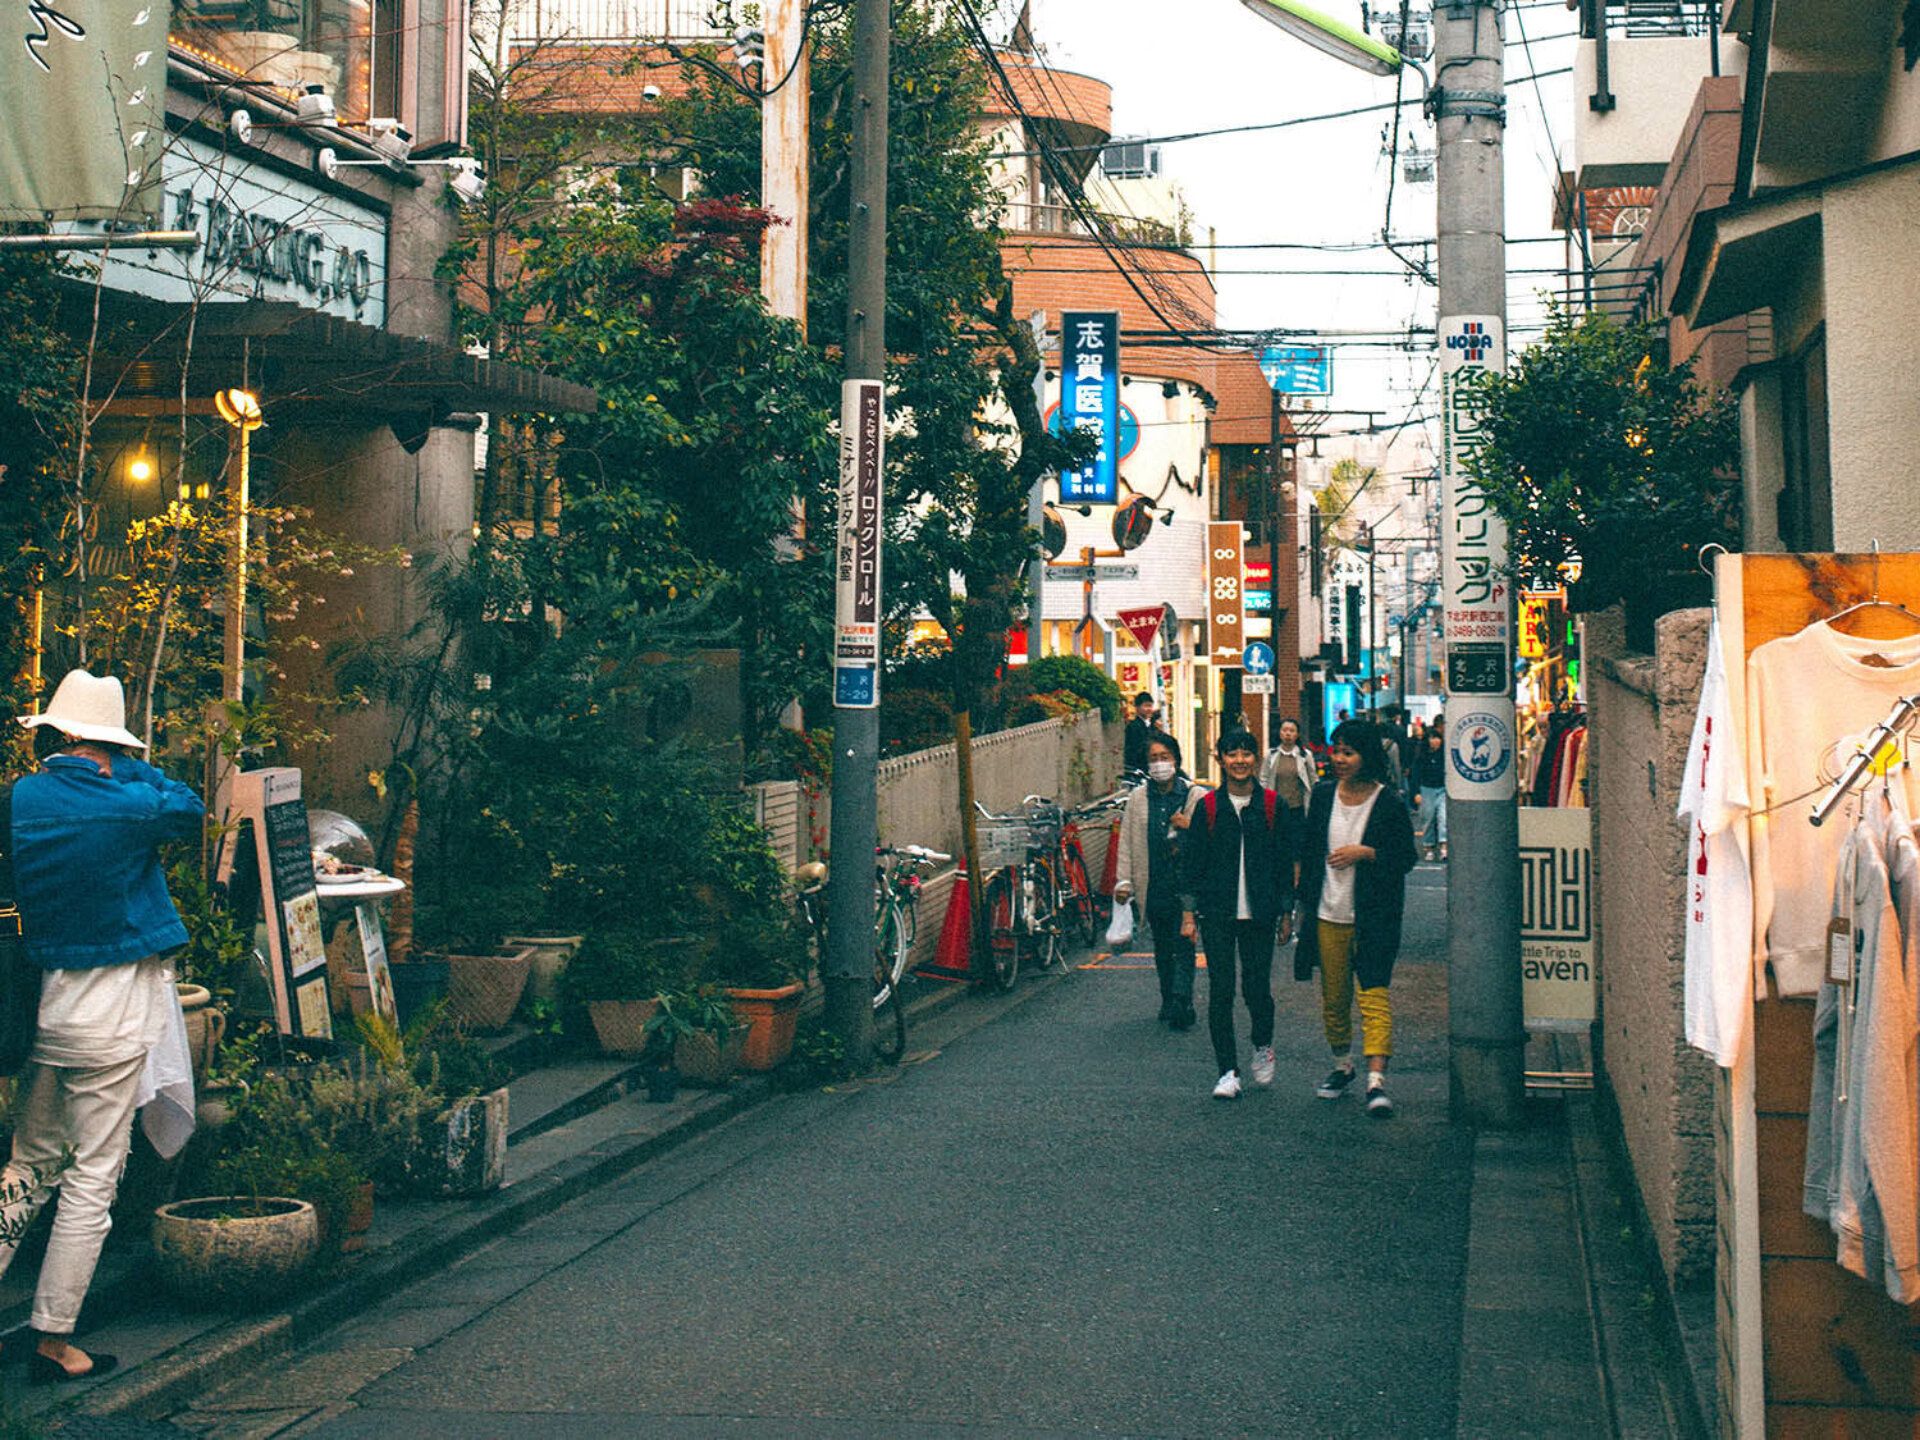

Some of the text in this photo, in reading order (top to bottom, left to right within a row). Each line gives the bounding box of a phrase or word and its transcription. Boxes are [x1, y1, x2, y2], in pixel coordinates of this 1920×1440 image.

[857, 496, 876, 606] ロックンロール
[1129, 615, 1158, 628] 止まれ
[1455, 675, 1497, 688] 2-26
[839, 689, 869, 701] 2-29
[1544, 946, 1566, 960] Trip
[1568, 948, 1582, 958] to
[1524, 960, 1589, 981] aven
